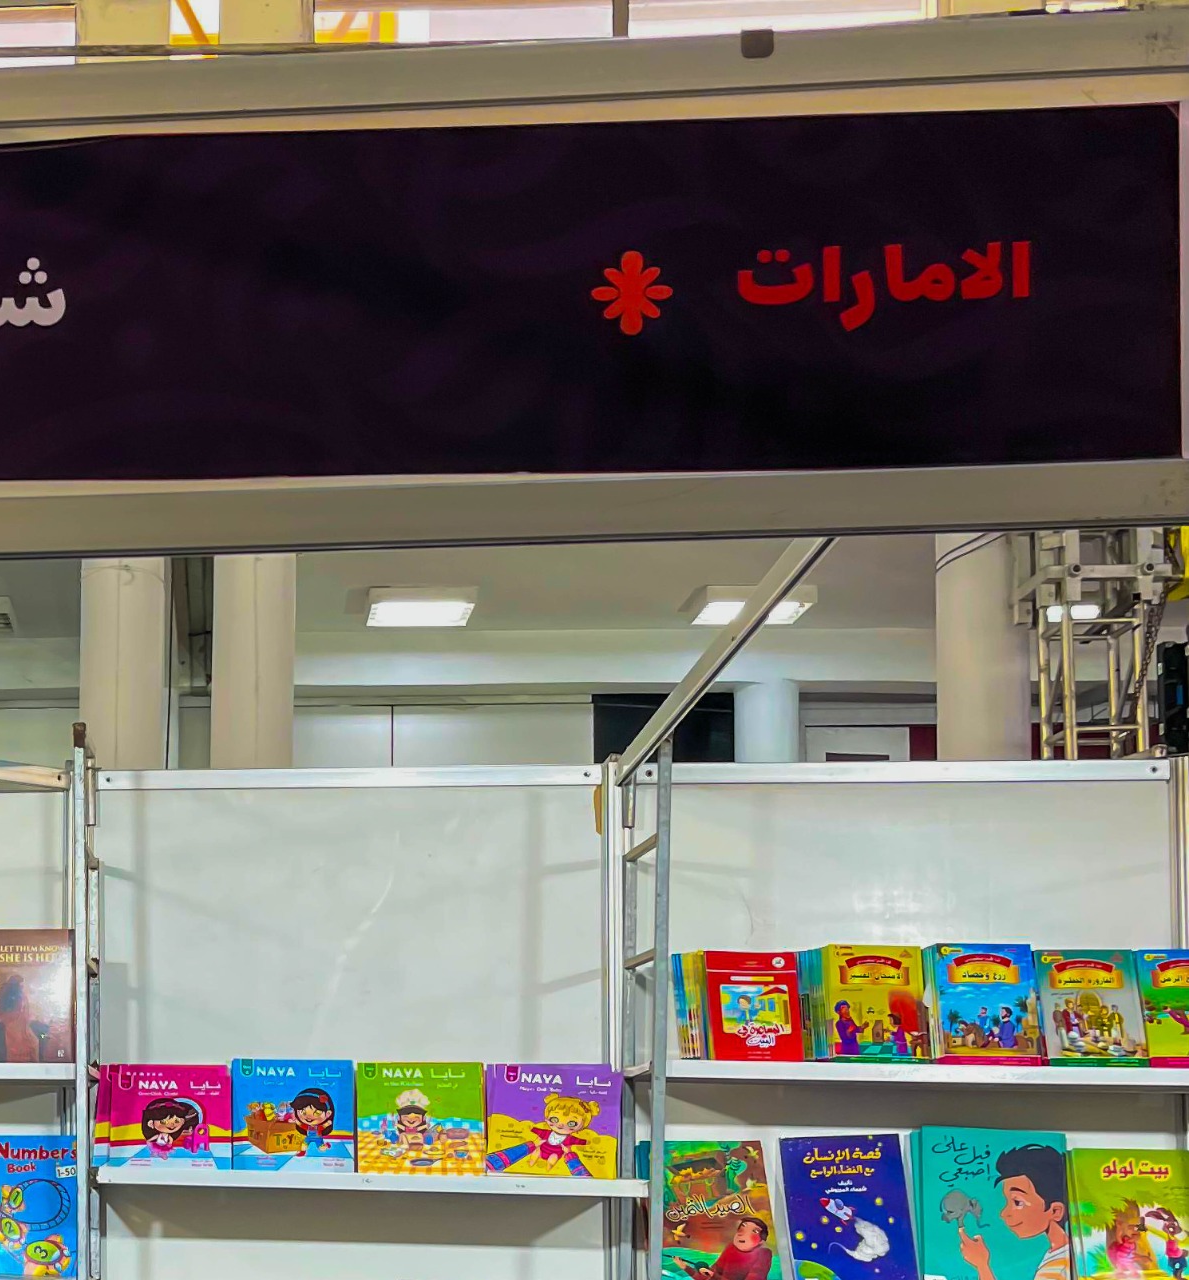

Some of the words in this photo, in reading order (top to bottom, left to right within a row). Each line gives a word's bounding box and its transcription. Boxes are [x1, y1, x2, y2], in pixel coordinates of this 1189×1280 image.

[737, 240, 1032, 332] الامارات
[0, 953, 21, 963] SHE
[23, 953, 33, 963] IS
[256, 1066, 296, 1077] NAYA
[382, 1067, 424, 1078] NAYA
[138, 1080, 179, 1090] NAYA
[521, 1072, 563, 1085] NAYA
[931, 1135, 970, 1154] على
[954, 1145, 991, 1165] فيل
[7, 1161, 36, 1174] Book
[1101, 1159, 1135, 1179] لولو
[1138, 1161, 1170, 1180] بيت
